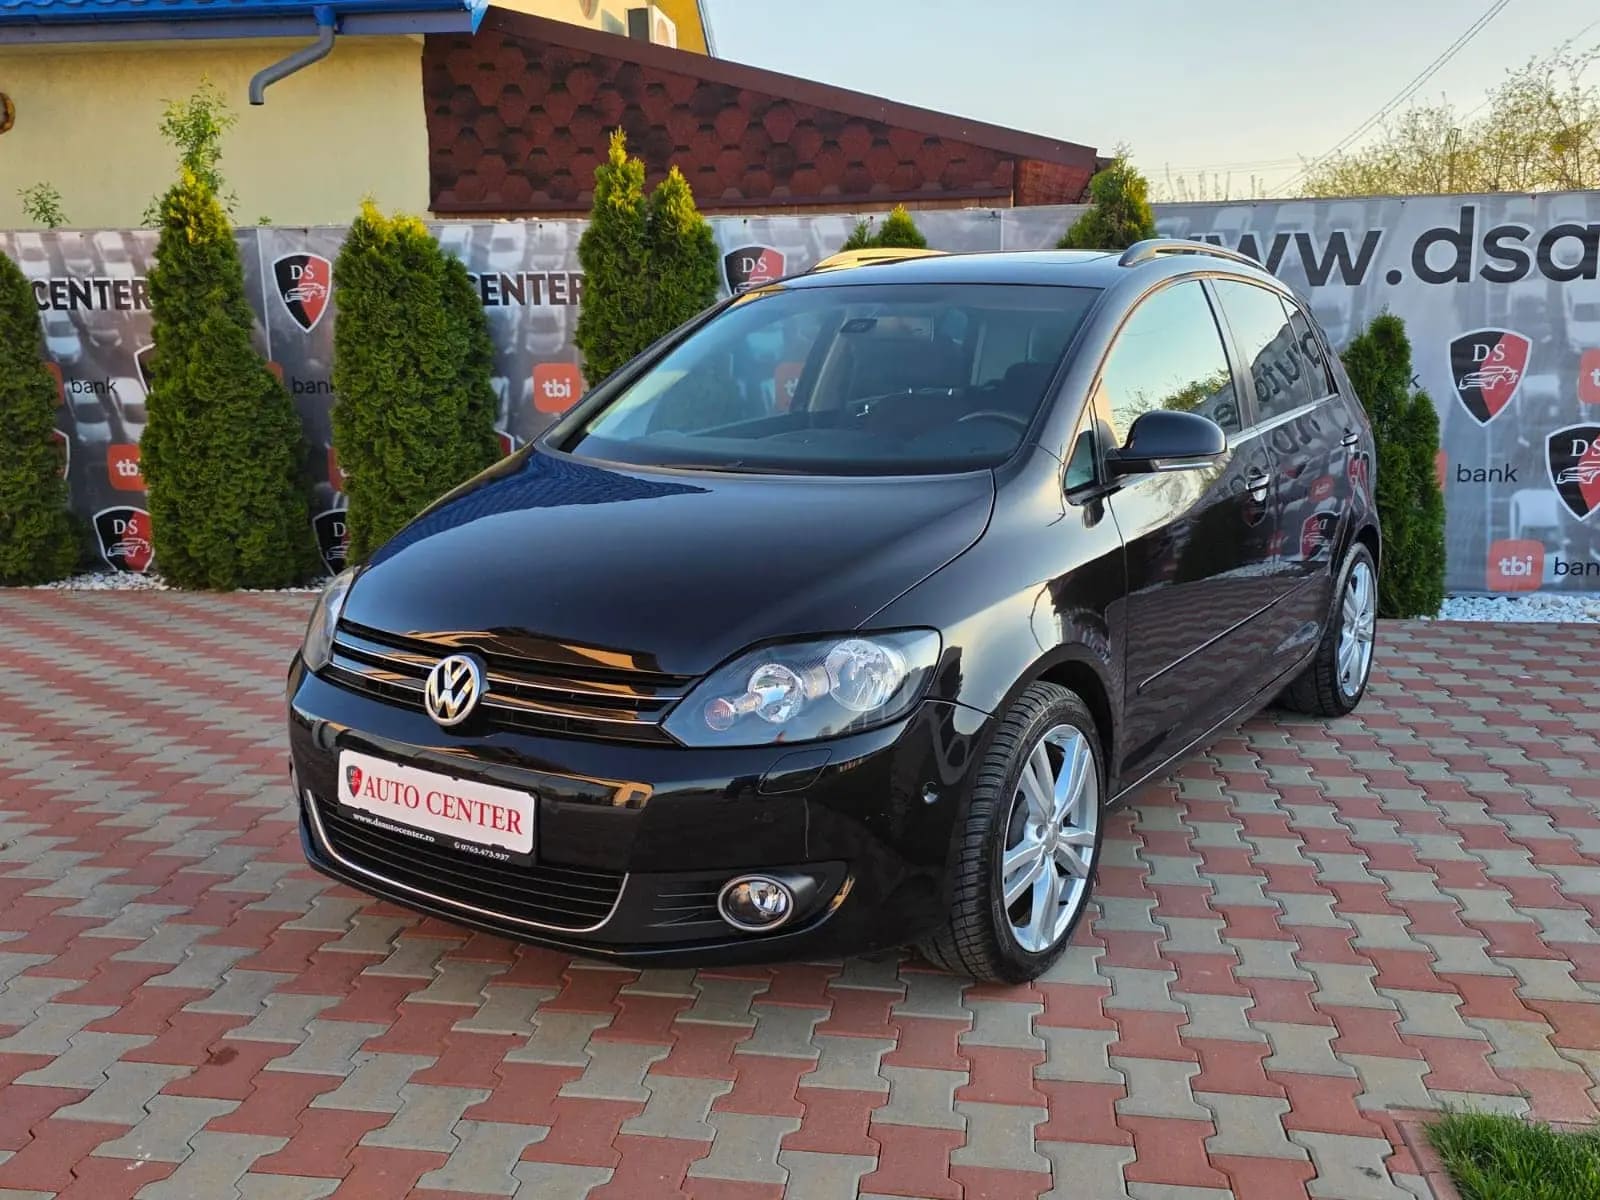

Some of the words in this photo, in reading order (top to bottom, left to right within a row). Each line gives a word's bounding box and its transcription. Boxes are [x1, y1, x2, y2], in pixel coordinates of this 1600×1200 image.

[291, 264, 315, 281] DS
[742, 257, 768, 273] DS
[31, 279, 153, 311] CENTER
[1472, 343, 1505, 362] DS
[71, 376, 118, 395] bank
[542, 378, 571, 398] tbi
[1456, 463, 1519, 483] bank
[113, 519, 138, 535] DS
[1498, 555, 1533, 576] tbi
[363, 776, 420, 809] AUTO
[426, 790, 523, 836] CENTER
